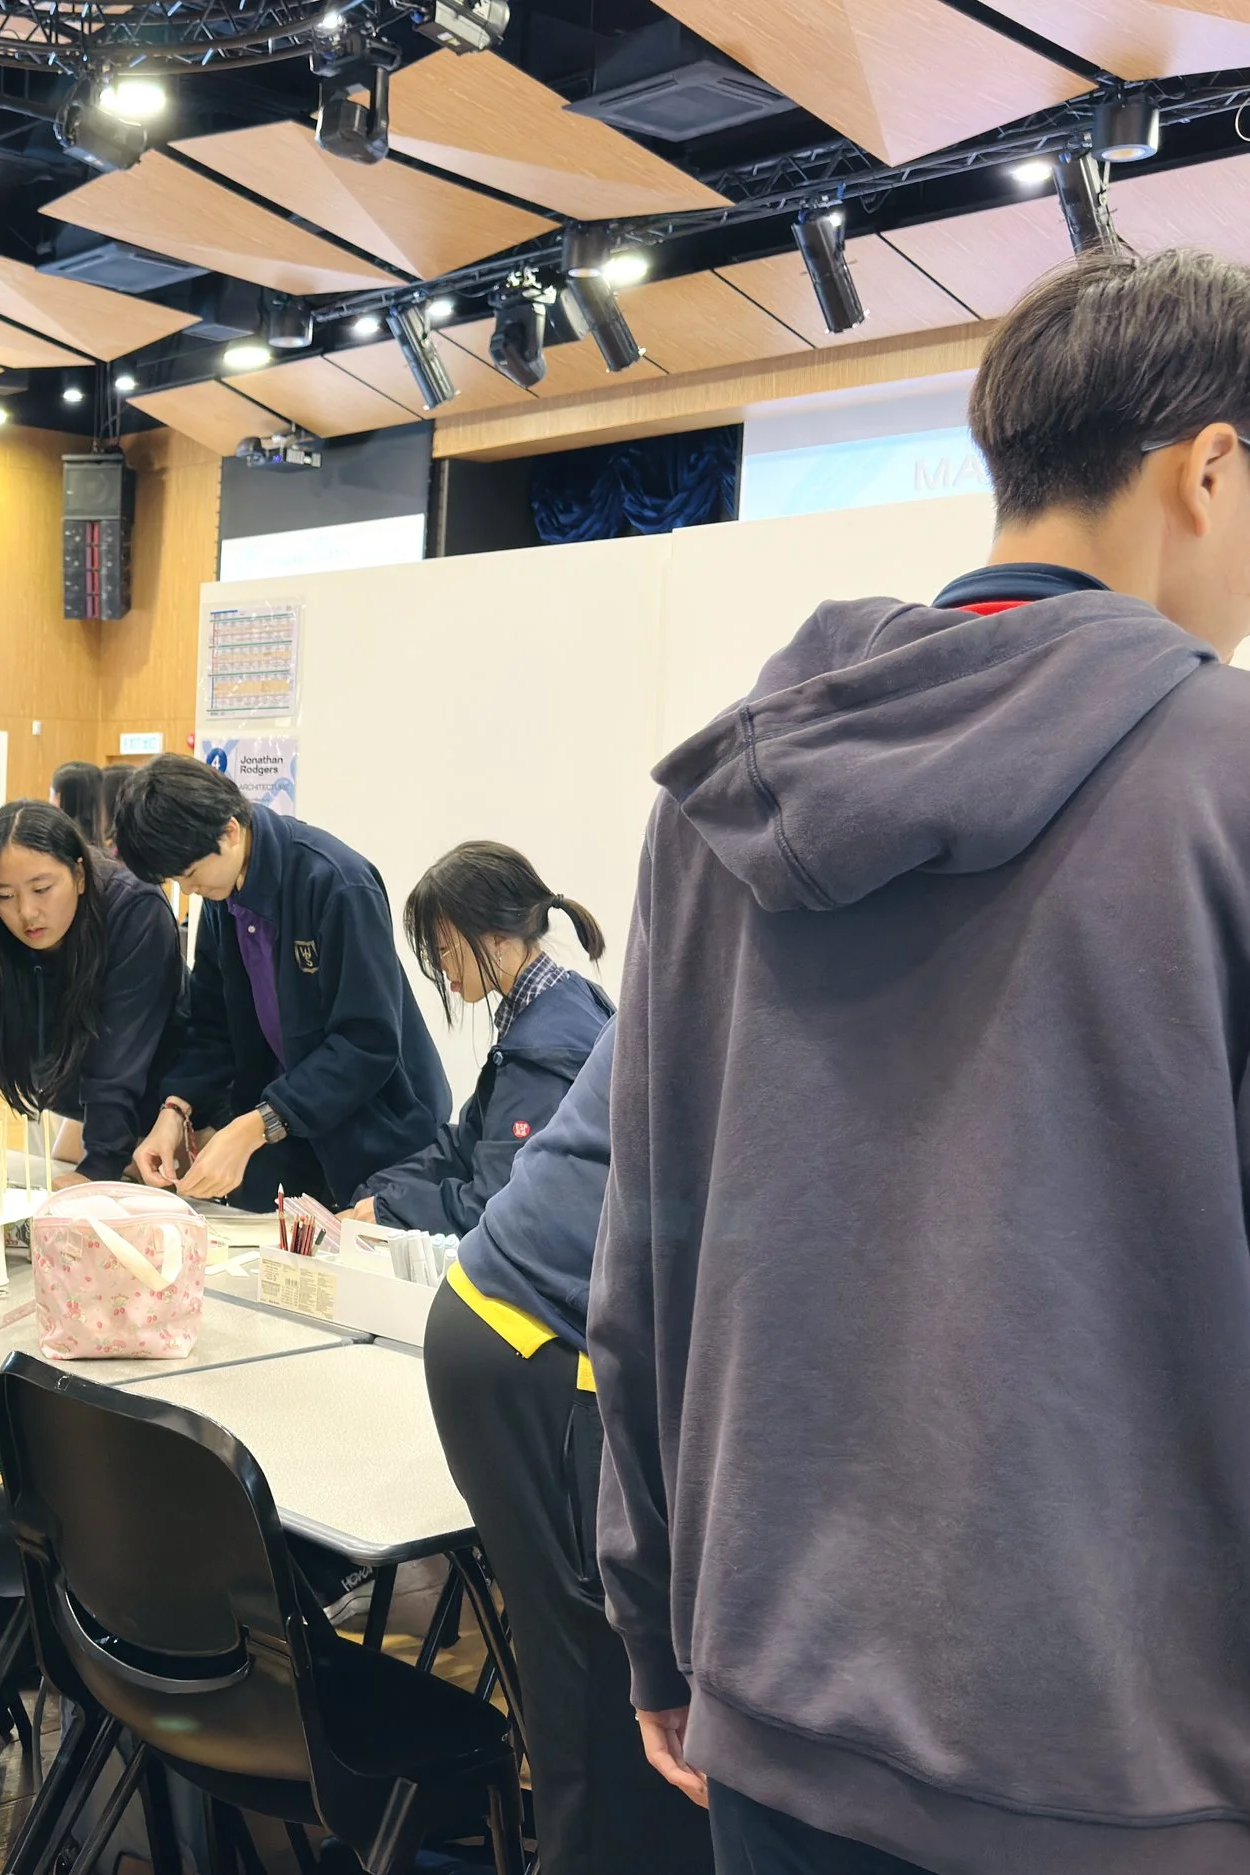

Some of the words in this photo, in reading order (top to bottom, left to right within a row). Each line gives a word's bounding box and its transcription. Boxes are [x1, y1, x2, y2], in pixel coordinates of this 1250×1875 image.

[211, 754, 221, 770] 4
[240, 755, 284, 765] Jonathan
[240, 765, 278, 776] Rodgers
